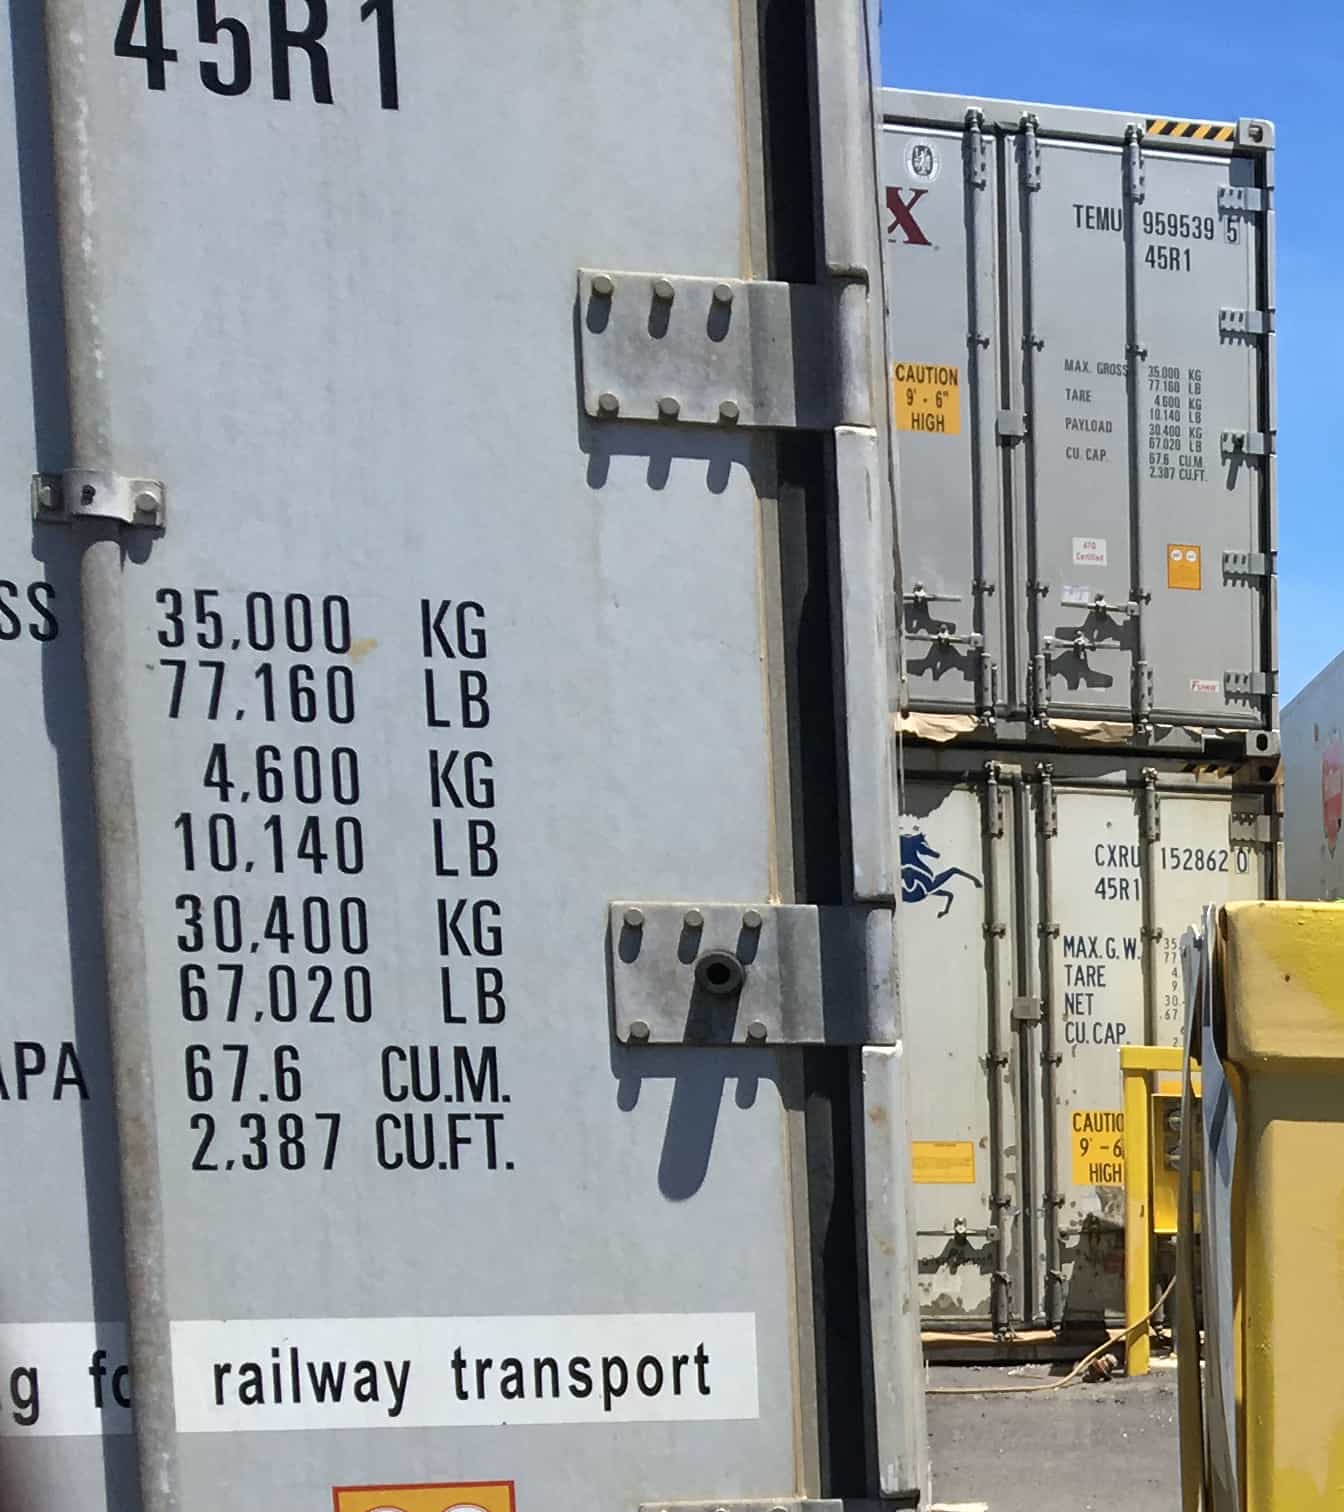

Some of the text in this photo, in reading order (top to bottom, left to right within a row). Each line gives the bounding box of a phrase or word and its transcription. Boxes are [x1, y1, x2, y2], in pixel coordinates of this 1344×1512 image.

[1072, 203, 1238, 244] TEMU 959539 5
[1145, 245, 1191, 272] 45R1
[895, 364, 958, 386] CAUTION
[1096, 362, 1128, 377] GROSS
[1188, 368, 1202, 381] KG
[1065, 388, 1092, 402] TARE
[1188, 398, 1202, 410] KG
[1188, 382, 1201, 394] LB
[911, 412, 945, 433] HIGH
[1065, 417, 1113, 433] PAYLOAD
[1189, 427, 1203, 439] KG
[1188, 411, 1202, 424] LB
[1189, 440, 1202, 452] LB
[420, 600, 488, 660] KG
[425, 668, 491, 729] LB
[428, 749, 497, 809] KG
[433, 820, 500, 878] LB
[1095, 844, 1141, 868] CXRU
[1161, 847, 1229, 872] 152862
[1095, 877, 1140, 900] 45R1
[436, 899, 504, 957] KG
[1064, 964, 1107, 987] TARE
[441, 966, 508, 1026] LB
[1064, 992, 1094, 1016] NET
[184, 1043, 303, 1104] 67.6
[379, 1044, 513, 1105] CU.M.
[1072, 1112, 1124, 1133] CAUTIO
[375, 1113, 517, 1172] CU.FT.
[1089, 1163, 1122, 1183] HIGH
[88, 1349, 131, 1409] fo
[212, 1345, 411, 1416] railway
[450, 1341, 714, 1412] transport
